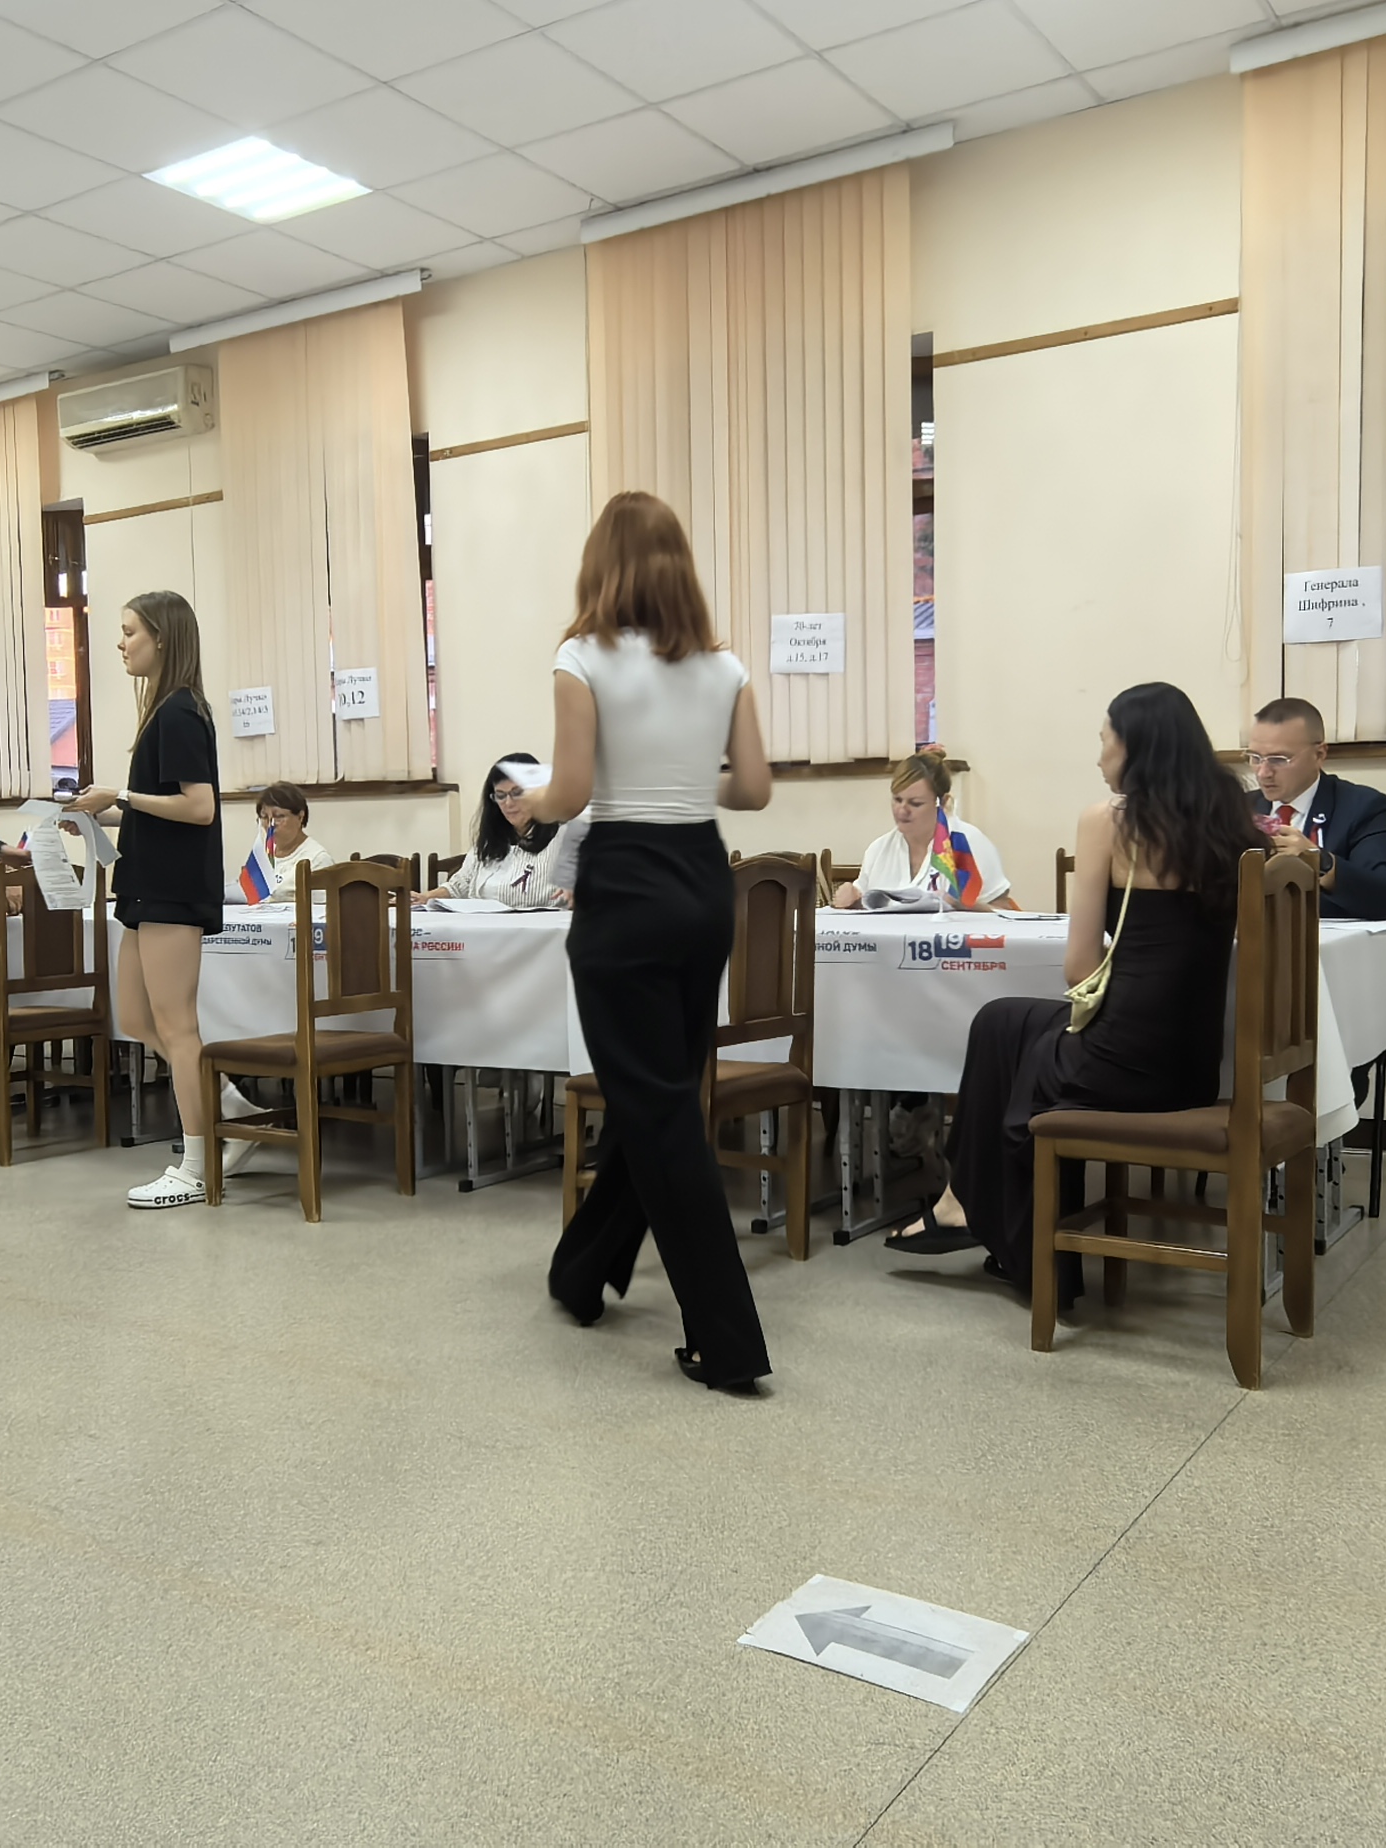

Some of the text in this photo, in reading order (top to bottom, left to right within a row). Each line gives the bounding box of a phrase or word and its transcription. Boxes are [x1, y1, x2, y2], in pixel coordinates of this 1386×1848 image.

[1304, 579, 1359, 592] Генерала
[1298, 598, 1359, 612] Шифрина
[1326, 617, 1334, 629] 7
[789, 636, 827, 649] Октября
[843, 943, 877, 954] ДУМЫ
[908, 941, 933, 961] 18
[941, 960, 1007, 971] СЕНТЯБРЯ
[154, 1193, 190, 1205] crocs
